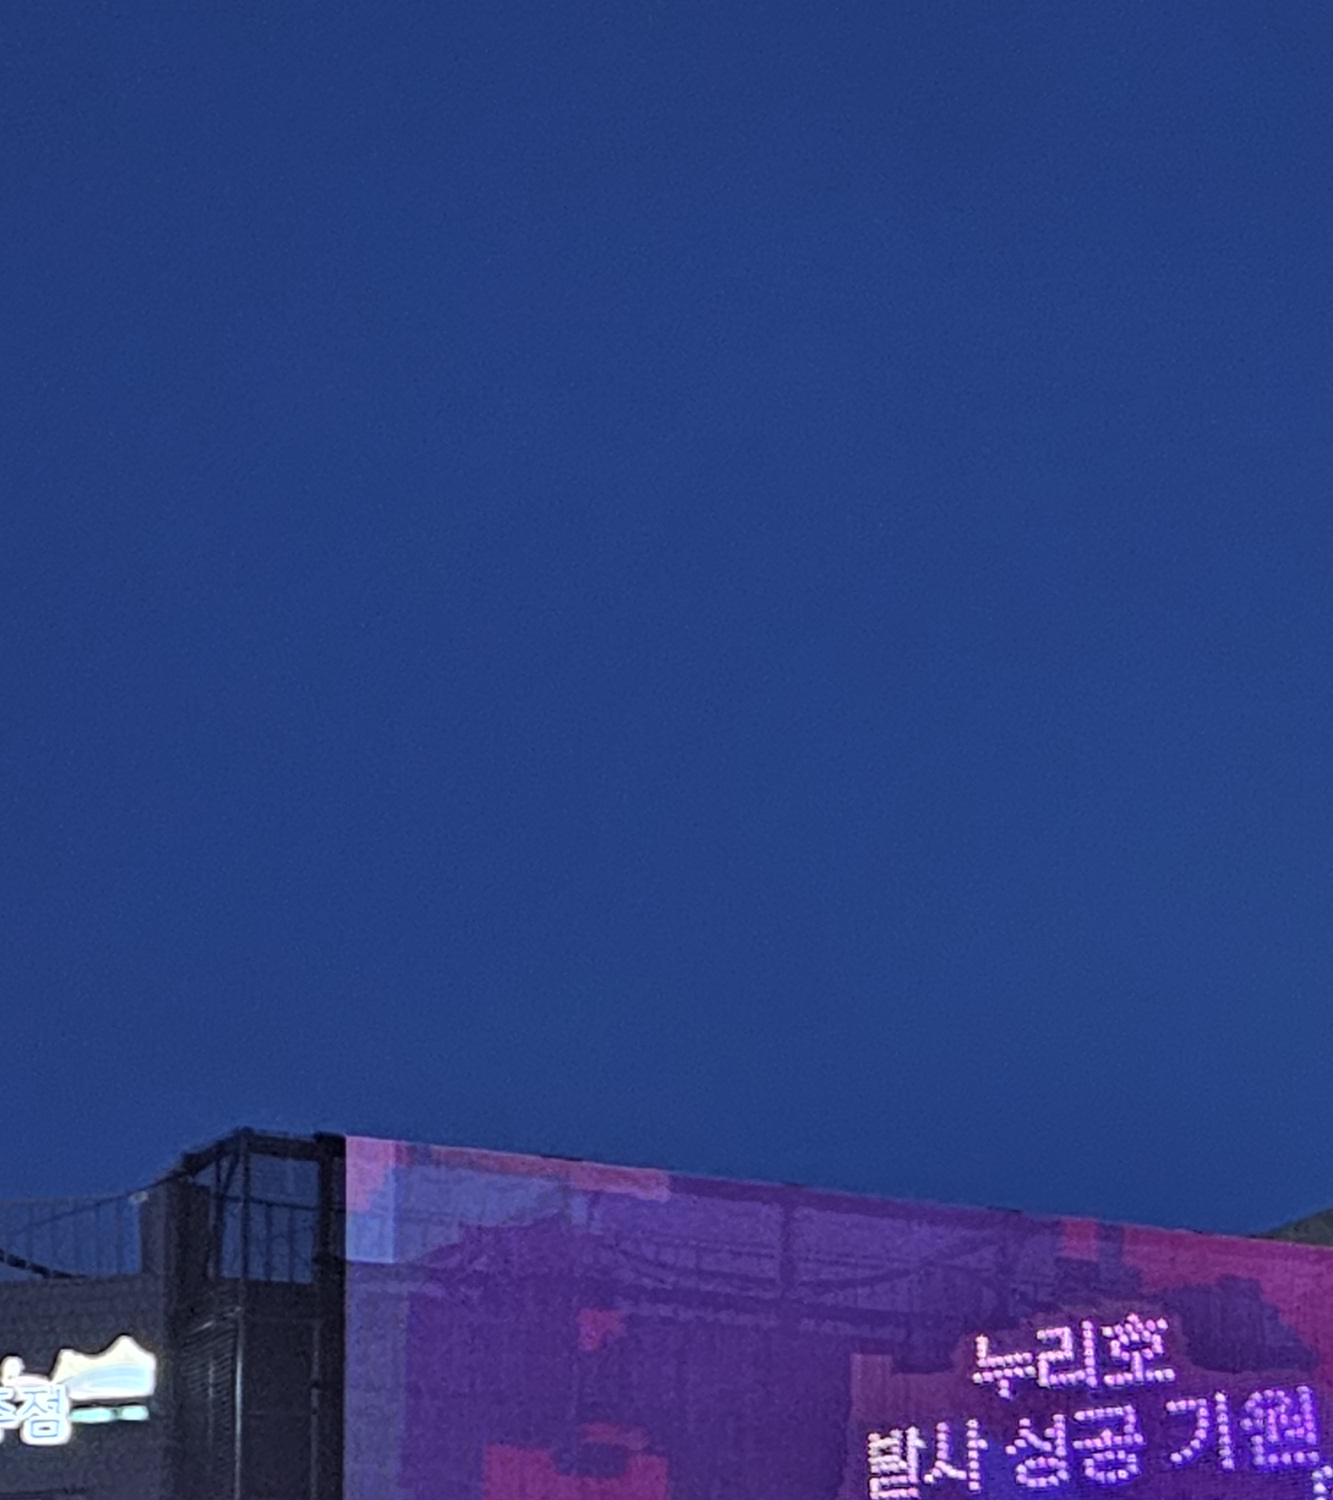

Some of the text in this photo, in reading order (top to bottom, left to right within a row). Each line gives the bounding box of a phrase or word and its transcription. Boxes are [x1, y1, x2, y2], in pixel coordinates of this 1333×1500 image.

[972, 1312, 1176, 1399] 누리호
[1005, 1404, 1146, 1490] 성공
[1164, 1385, 1322, 1471] 기원
